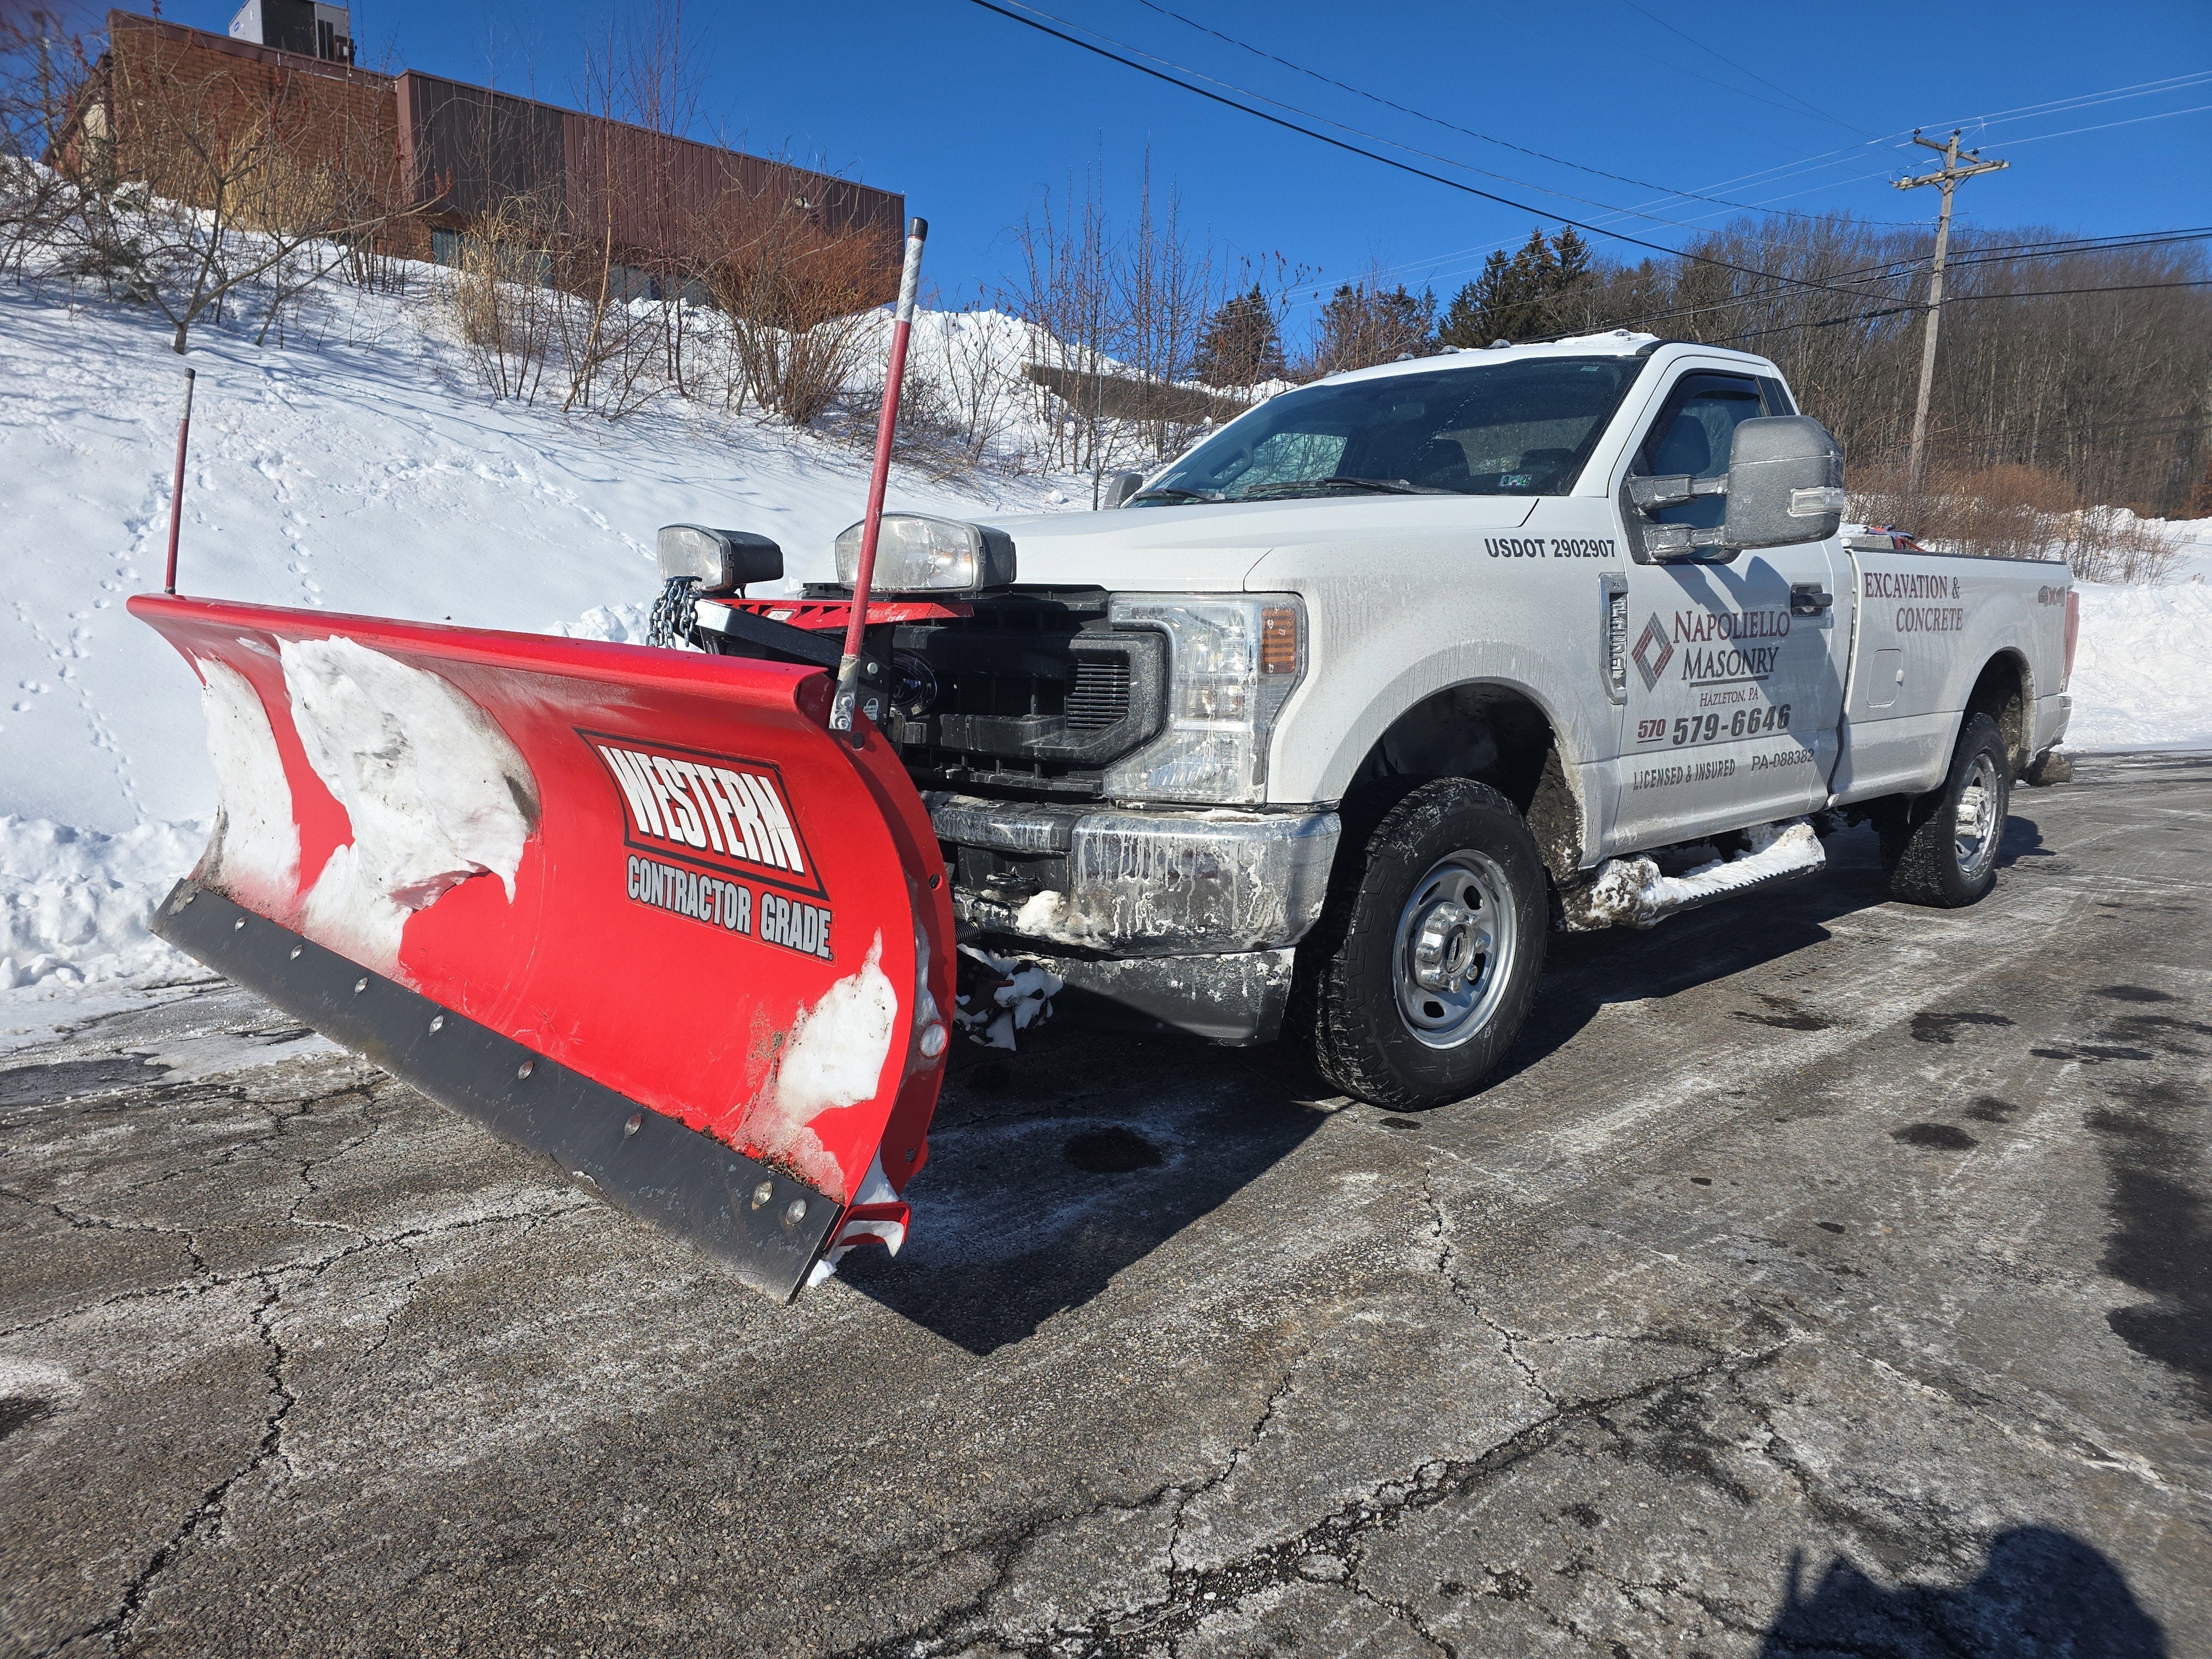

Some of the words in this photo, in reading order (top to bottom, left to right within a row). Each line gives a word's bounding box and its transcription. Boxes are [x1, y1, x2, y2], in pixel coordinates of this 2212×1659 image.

[1484, 538, 1546, 558] USDOT
[1551, 539, 1615, 558] 2902907
[1864, 572, 1947, 598] EXCAVATION
[1952, 577, 1960, 600] &
[1674, 610, 1790, 644] NAPOLIELLO
[1896, 607, 1964, 633] CONCRETE
[1681, 646, 1779, 681] MASONRY
[1700, 692, 1745, 707] HAZLETON,
[1748, 687, 1758, 701] PA
[1637, 718, 1666, 739] 570
[1672, 704, 1791, 745] 579-6646
[1632, 766, 1683, 790] LICENSED
[1686, 765, 1692, 783] &
[1694, 759, 1735, 781] INSURED
[1751, 748, 1815, 771] PA-088382
[599, 744, 805, 875] WESTERN
[626, 854, 751, 936] CONTRACTOR
[760, 892, 831, 959] GRADE
